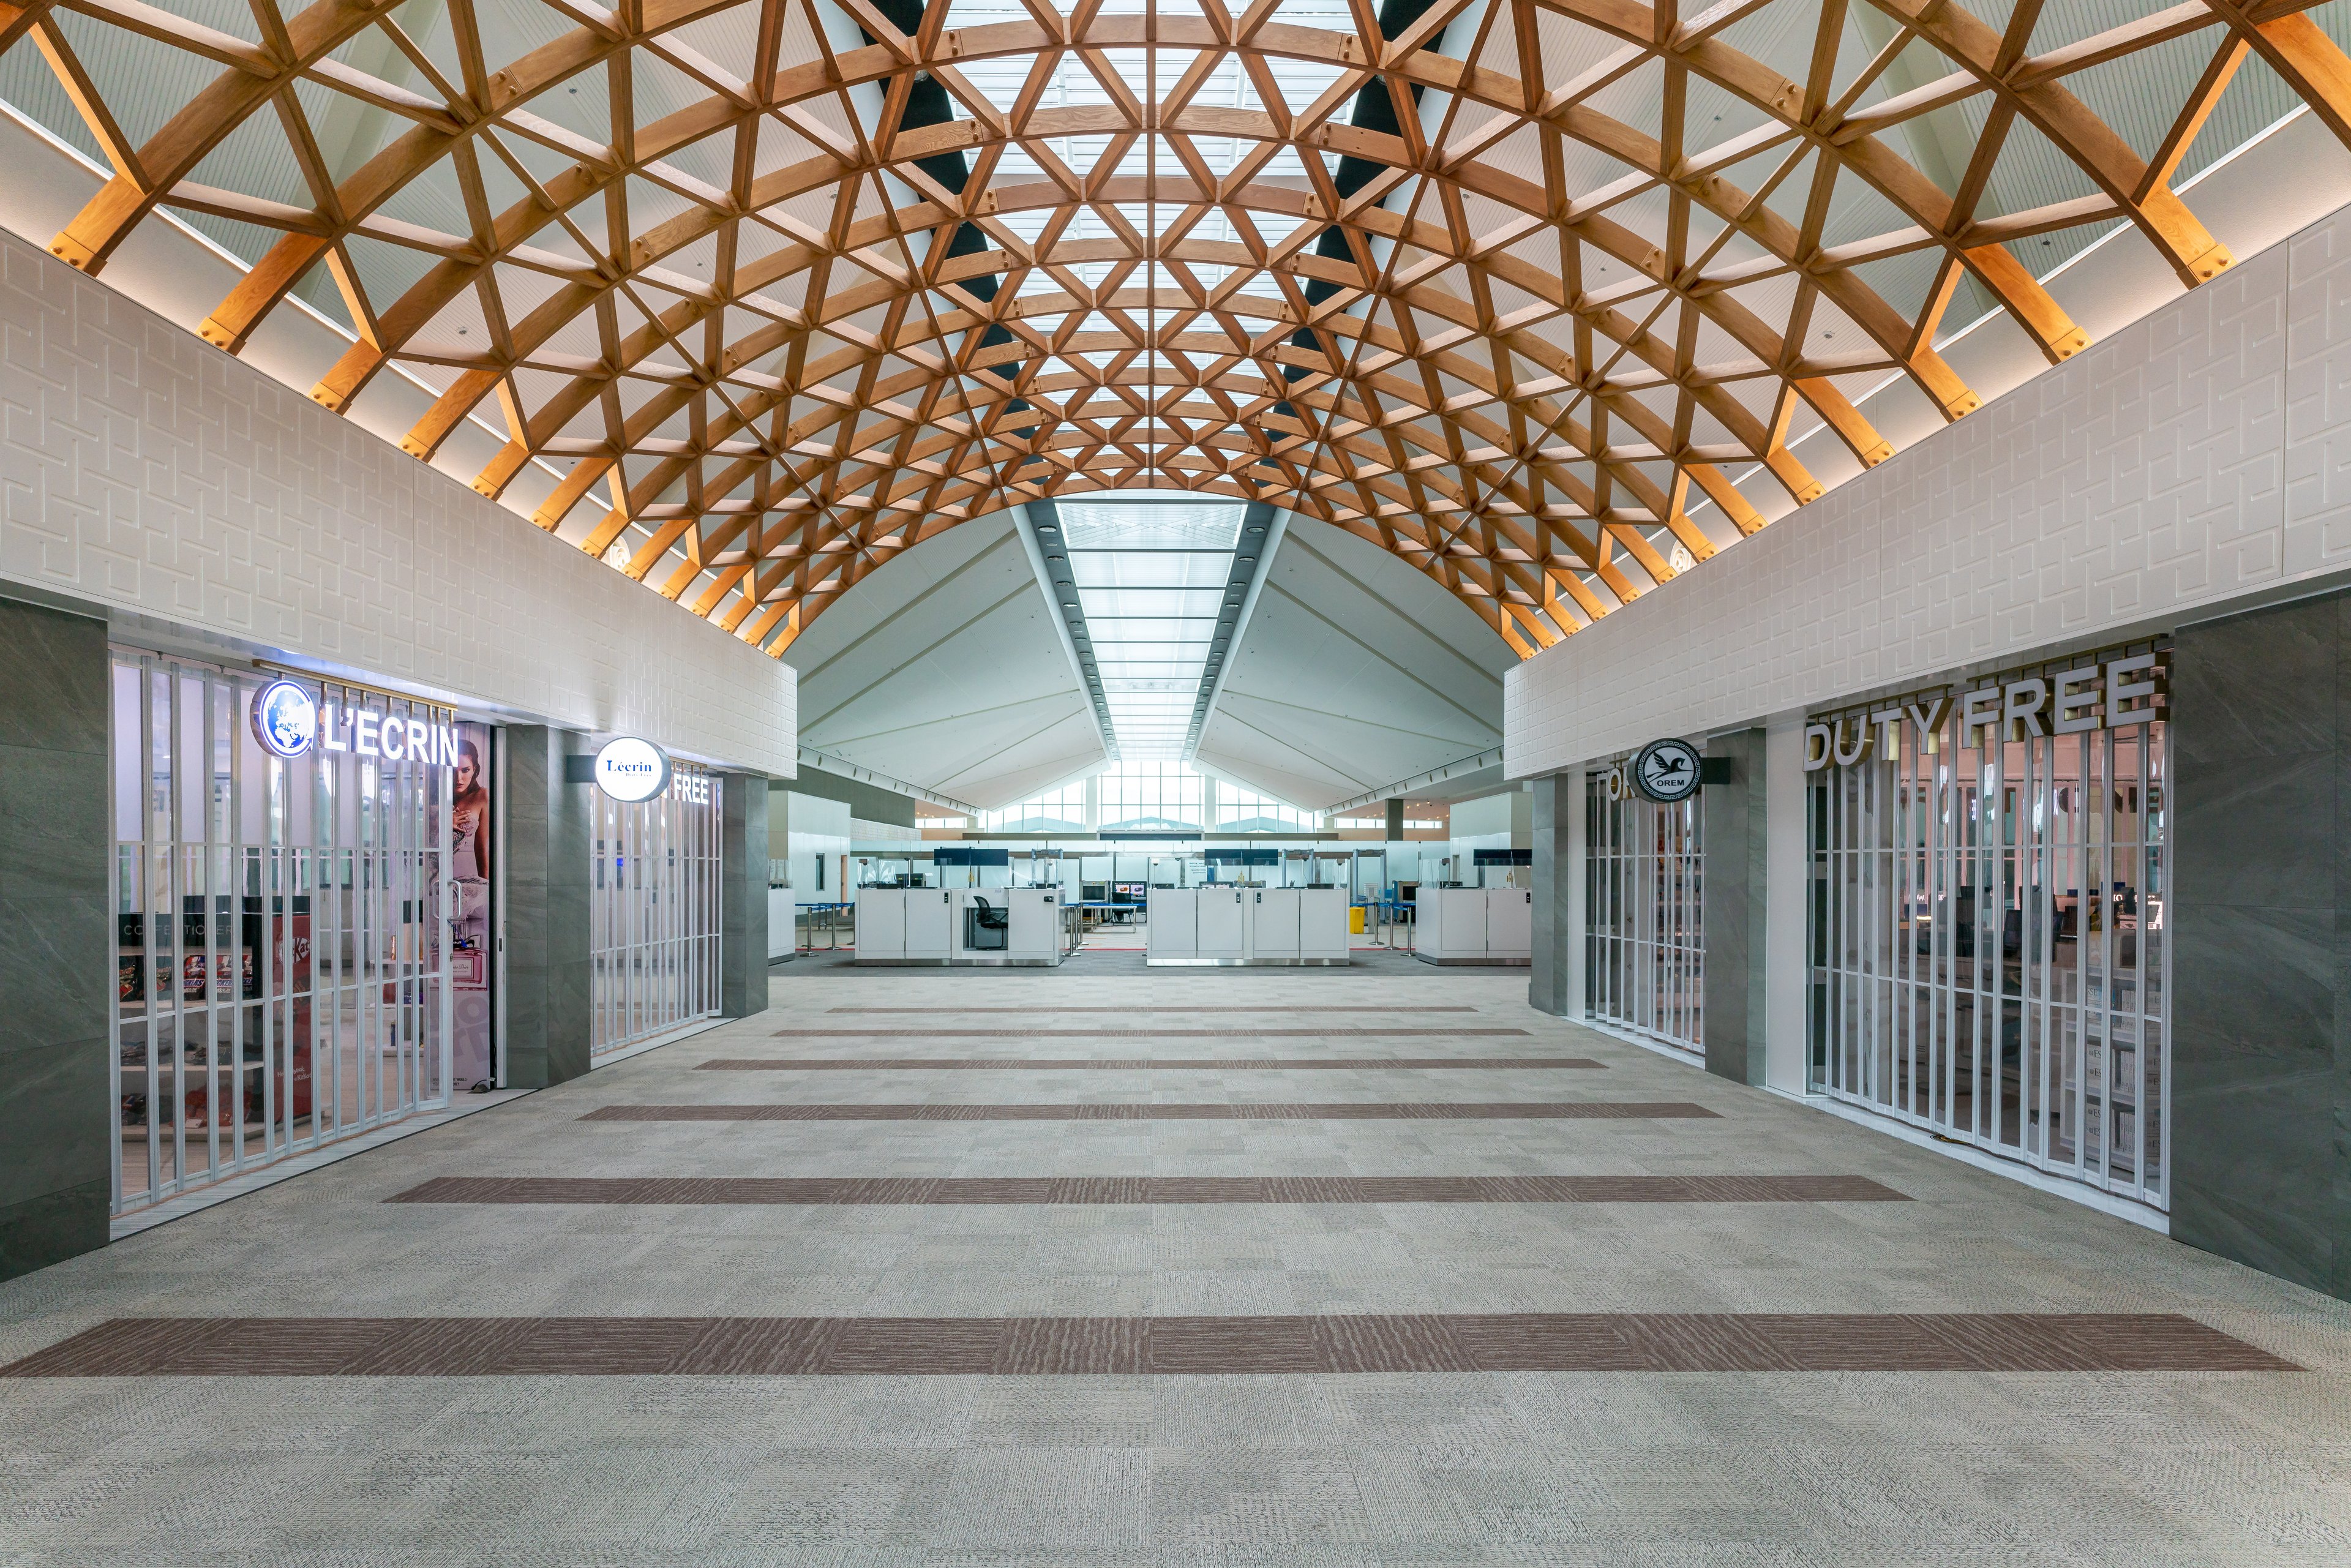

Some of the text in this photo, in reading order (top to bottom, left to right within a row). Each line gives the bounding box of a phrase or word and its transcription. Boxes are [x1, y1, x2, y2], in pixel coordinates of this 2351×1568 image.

[324, 703, 459, 767] L'ECRIN
[1802, 653, 2156, 771] DUTY FREE
[606, 760, 651, 771] Lécrin
[673, 773, 709, 805] FREE
